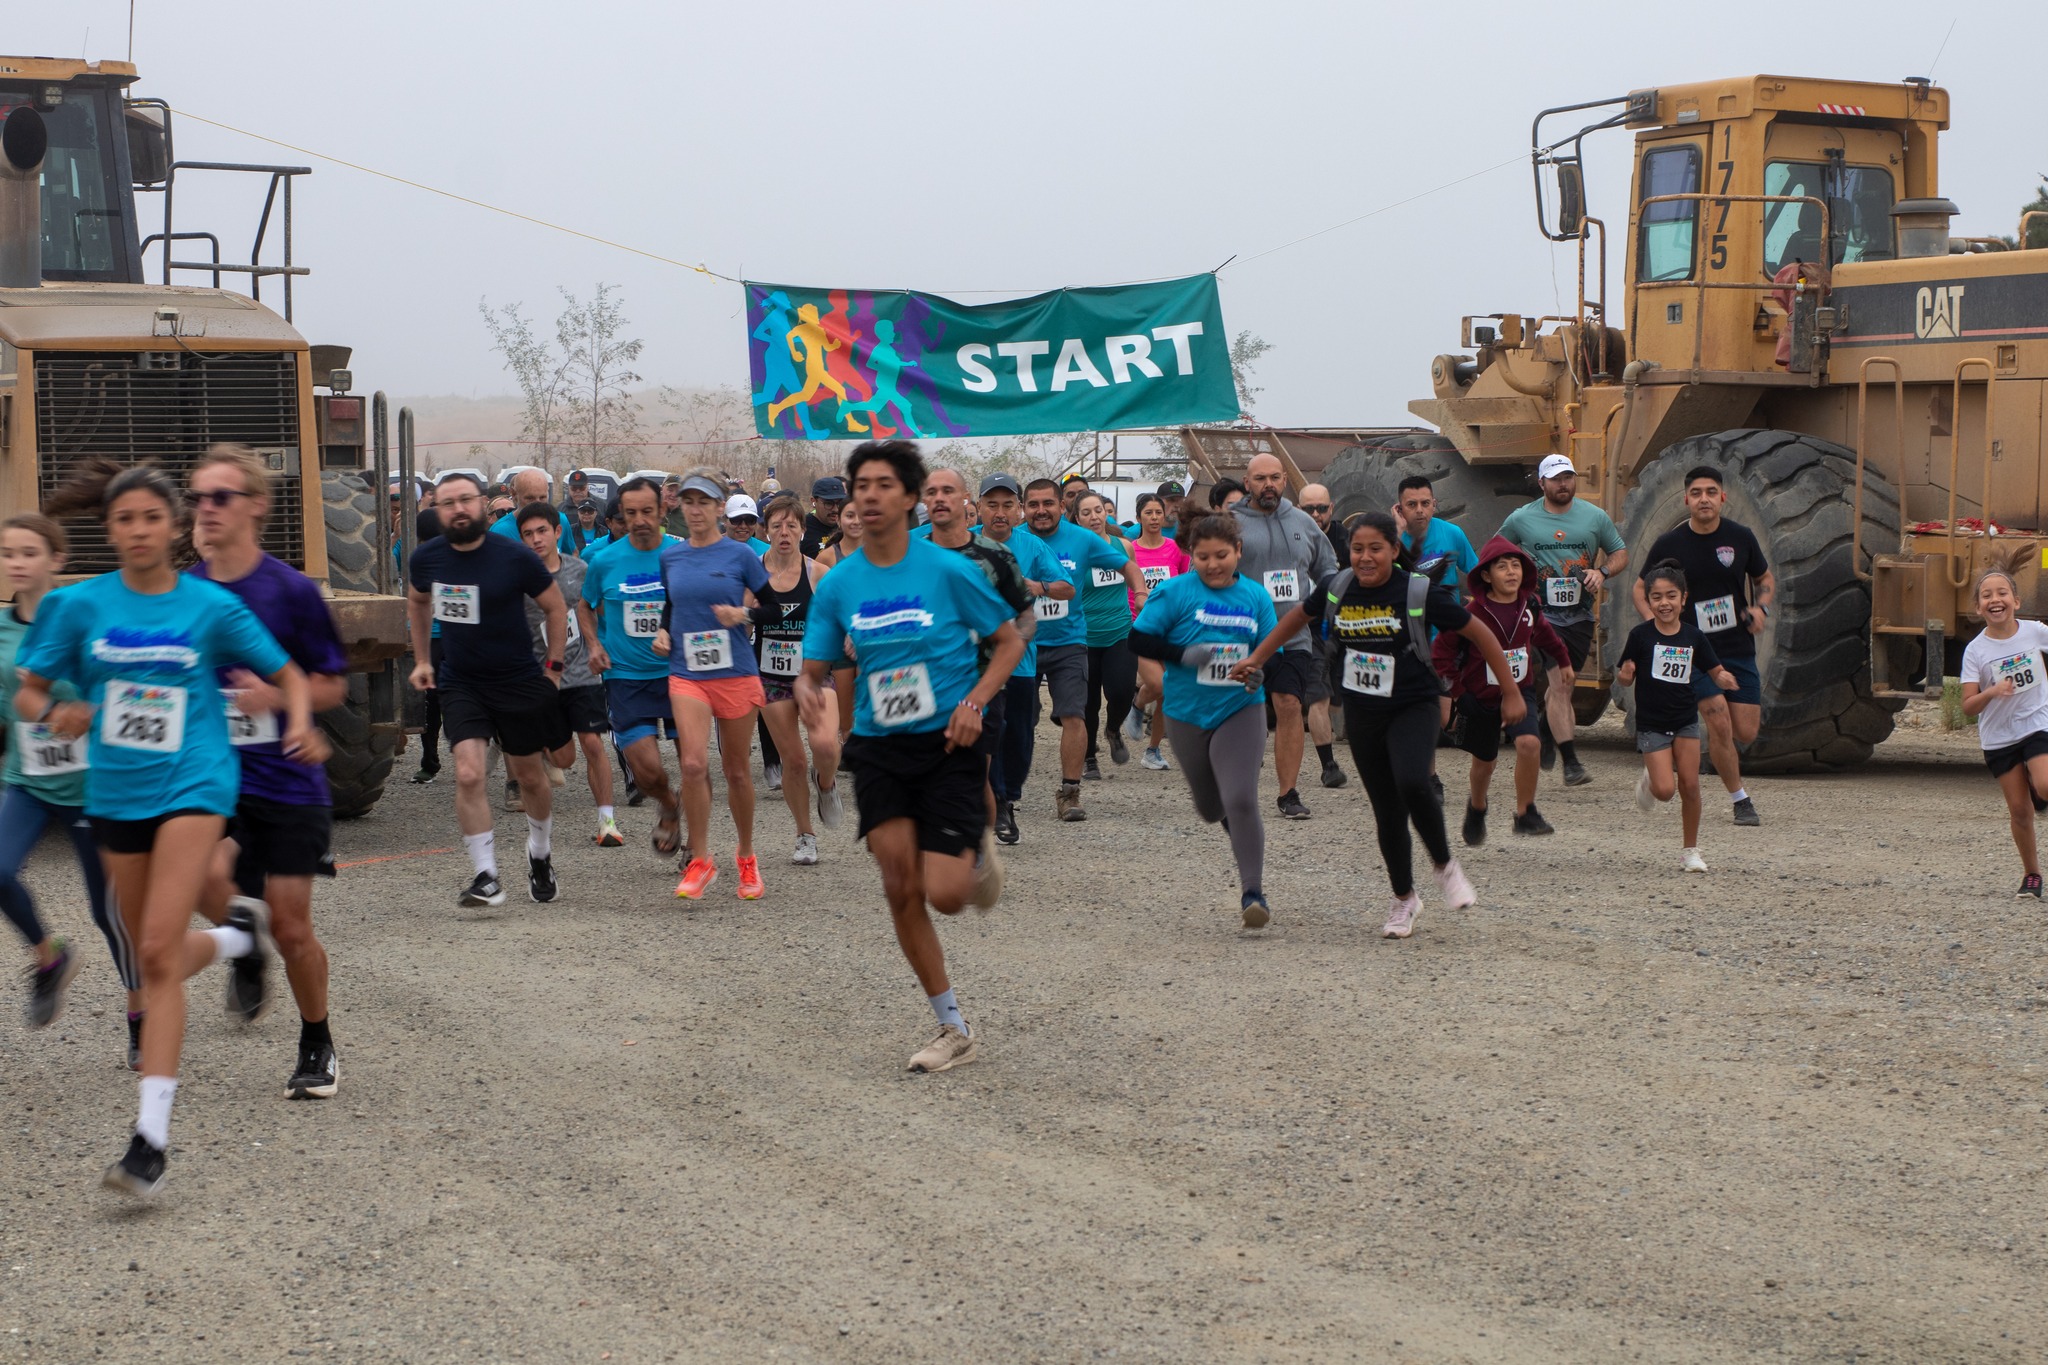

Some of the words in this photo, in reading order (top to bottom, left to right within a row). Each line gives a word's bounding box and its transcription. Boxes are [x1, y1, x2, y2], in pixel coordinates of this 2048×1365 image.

[1711, 125, 1734, 270] 1775
[1916, 286, 1964, 338] CAT
[956, 321, 1204, 393] START
[1534, 541, 1587, 551] Graniterock
[1099, 571, 1117, 582] 297
[1273, 585, 1292, 597] 146
[1554, 591, 1574, 603] 186
[1042, 603, 1060, 616] 112
[633, 618, 658, 633] 198
[782, 620, 806, 630] SUR
[1707, 612, 1728, 629] 148
[693, 649, 720, 666] 150
[771, 656, 792, 671] 151
[1662, 662, 1687, 679] 287
[1354, 671, 1381, 690] 144
